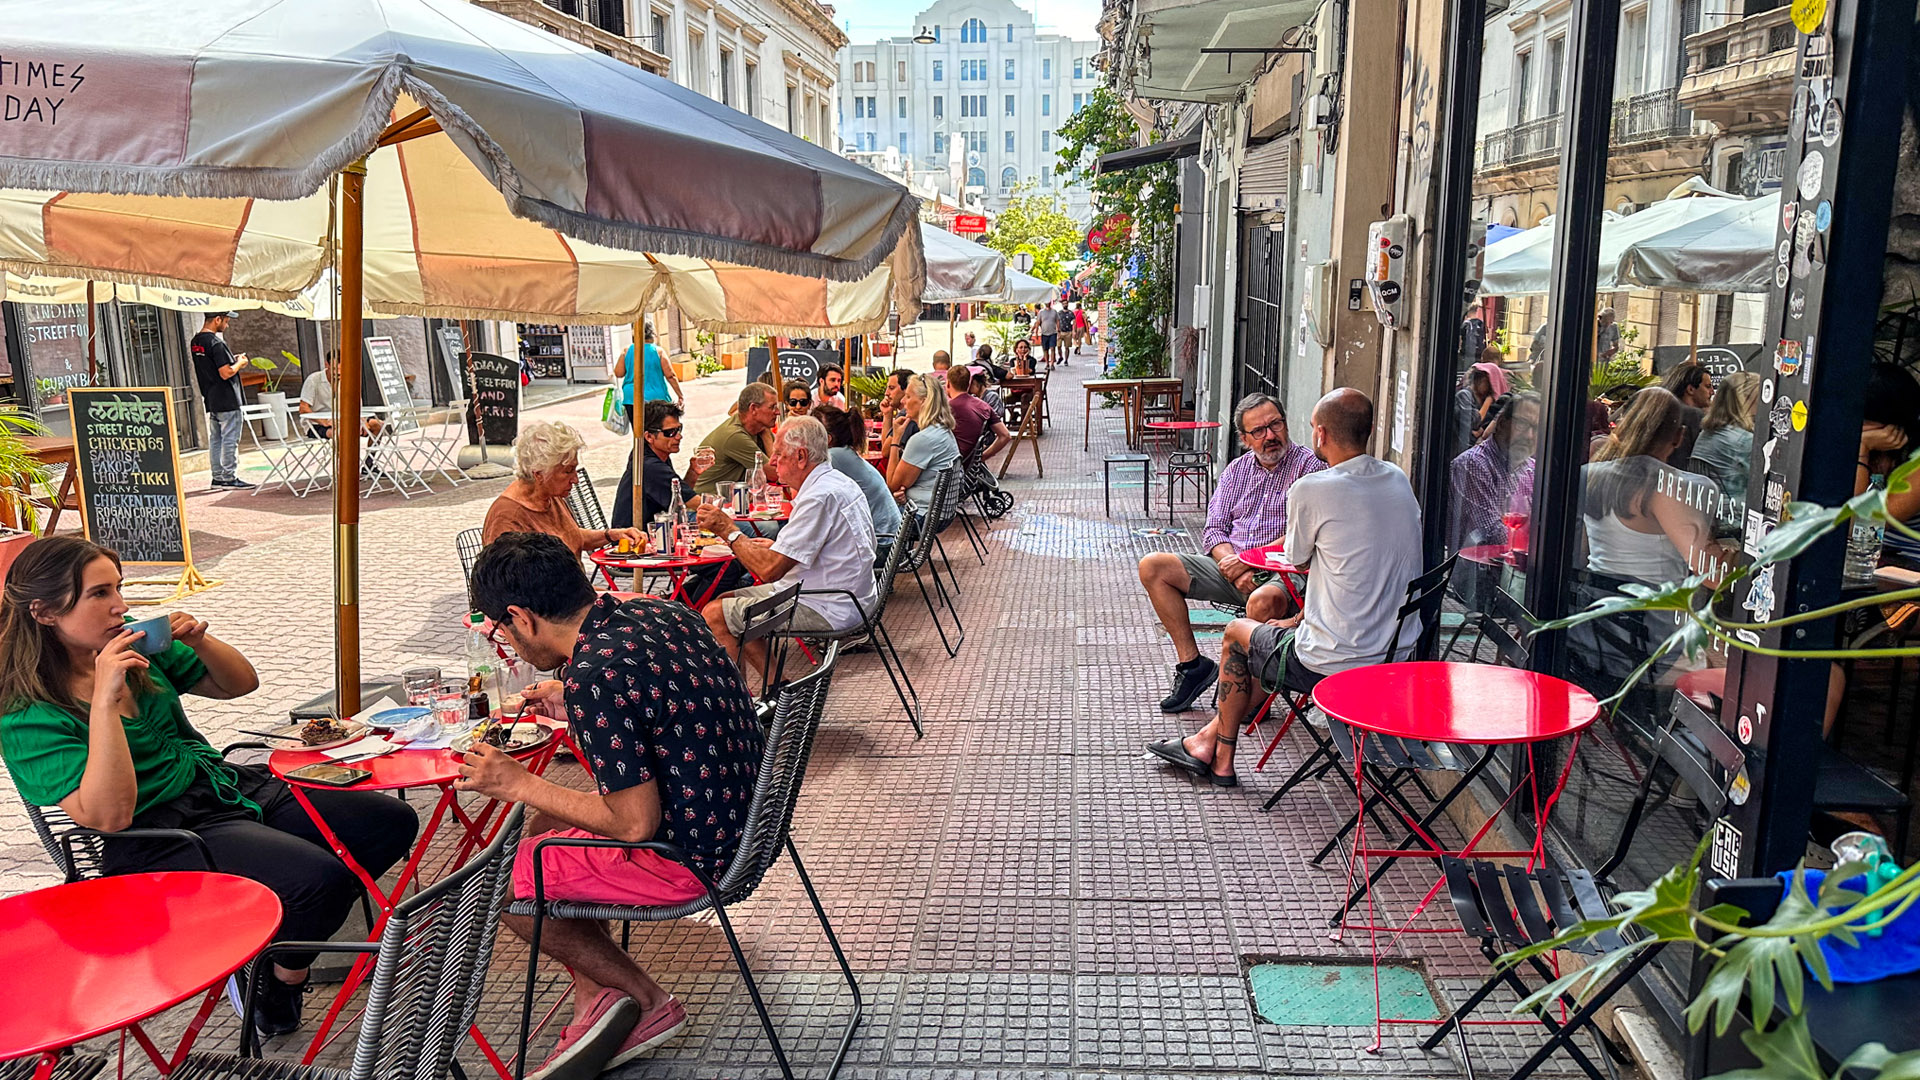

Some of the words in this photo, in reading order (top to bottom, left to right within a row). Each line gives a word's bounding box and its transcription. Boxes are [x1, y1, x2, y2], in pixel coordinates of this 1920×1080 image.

[5, 94, 64, 125] DAY
[35, 303, 85, 319] INDIAN
[28, 325, 67, 343] STREET
[70, 323, 88, 338] FOO
[65, 358, 72, 371] &
[779, 366, 812, 376] TRO
[42, 373, 78, 390] CURRY
[480, 391, 505, 400] AND
[87, 423, 123, 435] STREET
[127, 425, 152, 436] FOOD
[88, 437, 147, 451] CHICKEN
[148, 437, 164, 452] 65
[89, 450, 142, 462] SAMOSA
[91, 461, 141, 473] PAKODA
[93, 472, 129, 484] CHOLE
[131, 472, 169, 485] TIKKI
[1767, 480, 1783, 499] MAD
[93, 494, 143, 507] CHICKEN
[144, 495, 178, 508] TIKKA
[1657, 468, 1746, 530] BREAKFAST
[95, 506, 132, 518] ROGAN
[133, 506, 179, 518] CORDERO
[134, 517, 179, 530] MASALA
